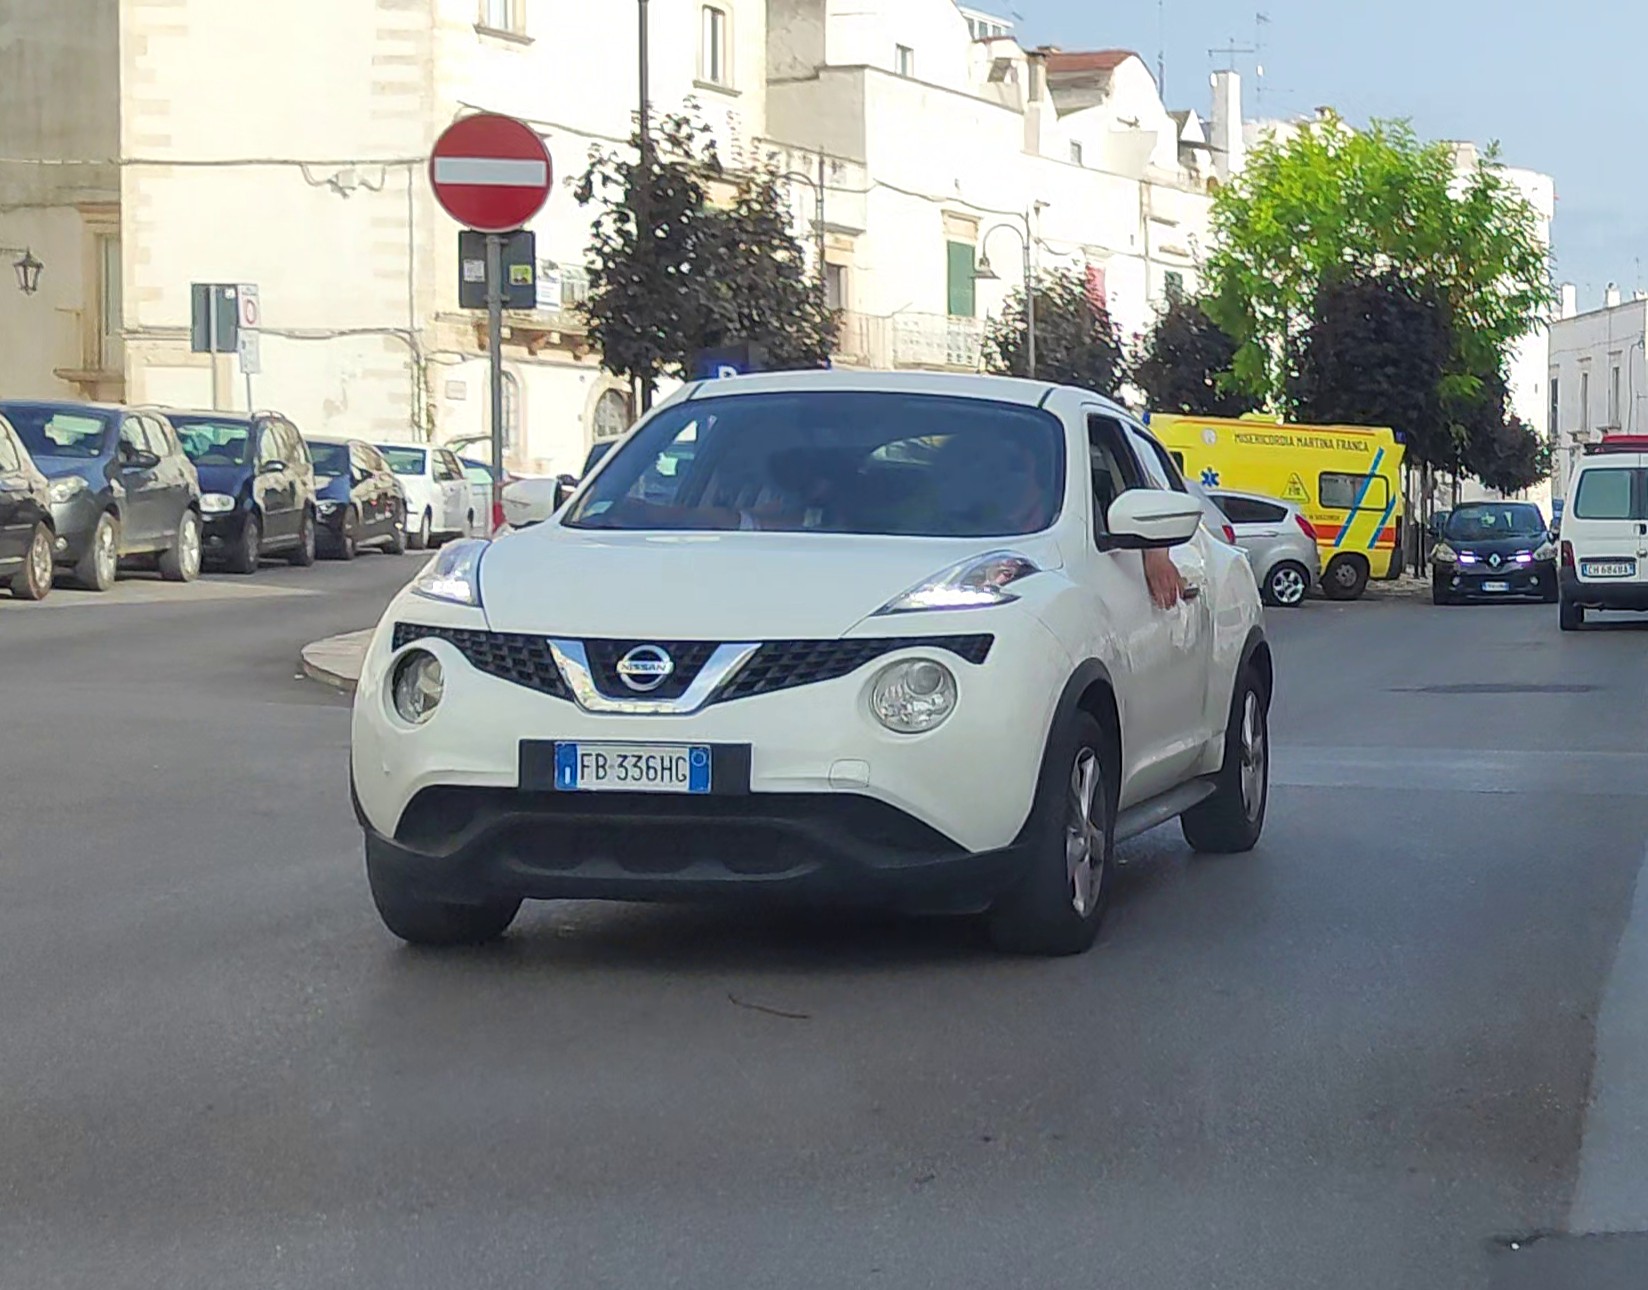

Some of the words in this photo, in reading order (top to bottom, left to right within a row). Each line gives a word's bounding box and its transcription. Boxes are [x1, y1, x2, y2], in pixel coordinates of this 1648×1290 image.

[1234, 433, 1294, 447] MISERICORDIA
[1295, 438, 1335, 450] MARTINA
[1336, 440, 1370, 453] FRANCA
[621, 662, 667, 672] NISSAN
[580, 752, 608, 781] FB
[616, 753, 688, 783] 336HG
